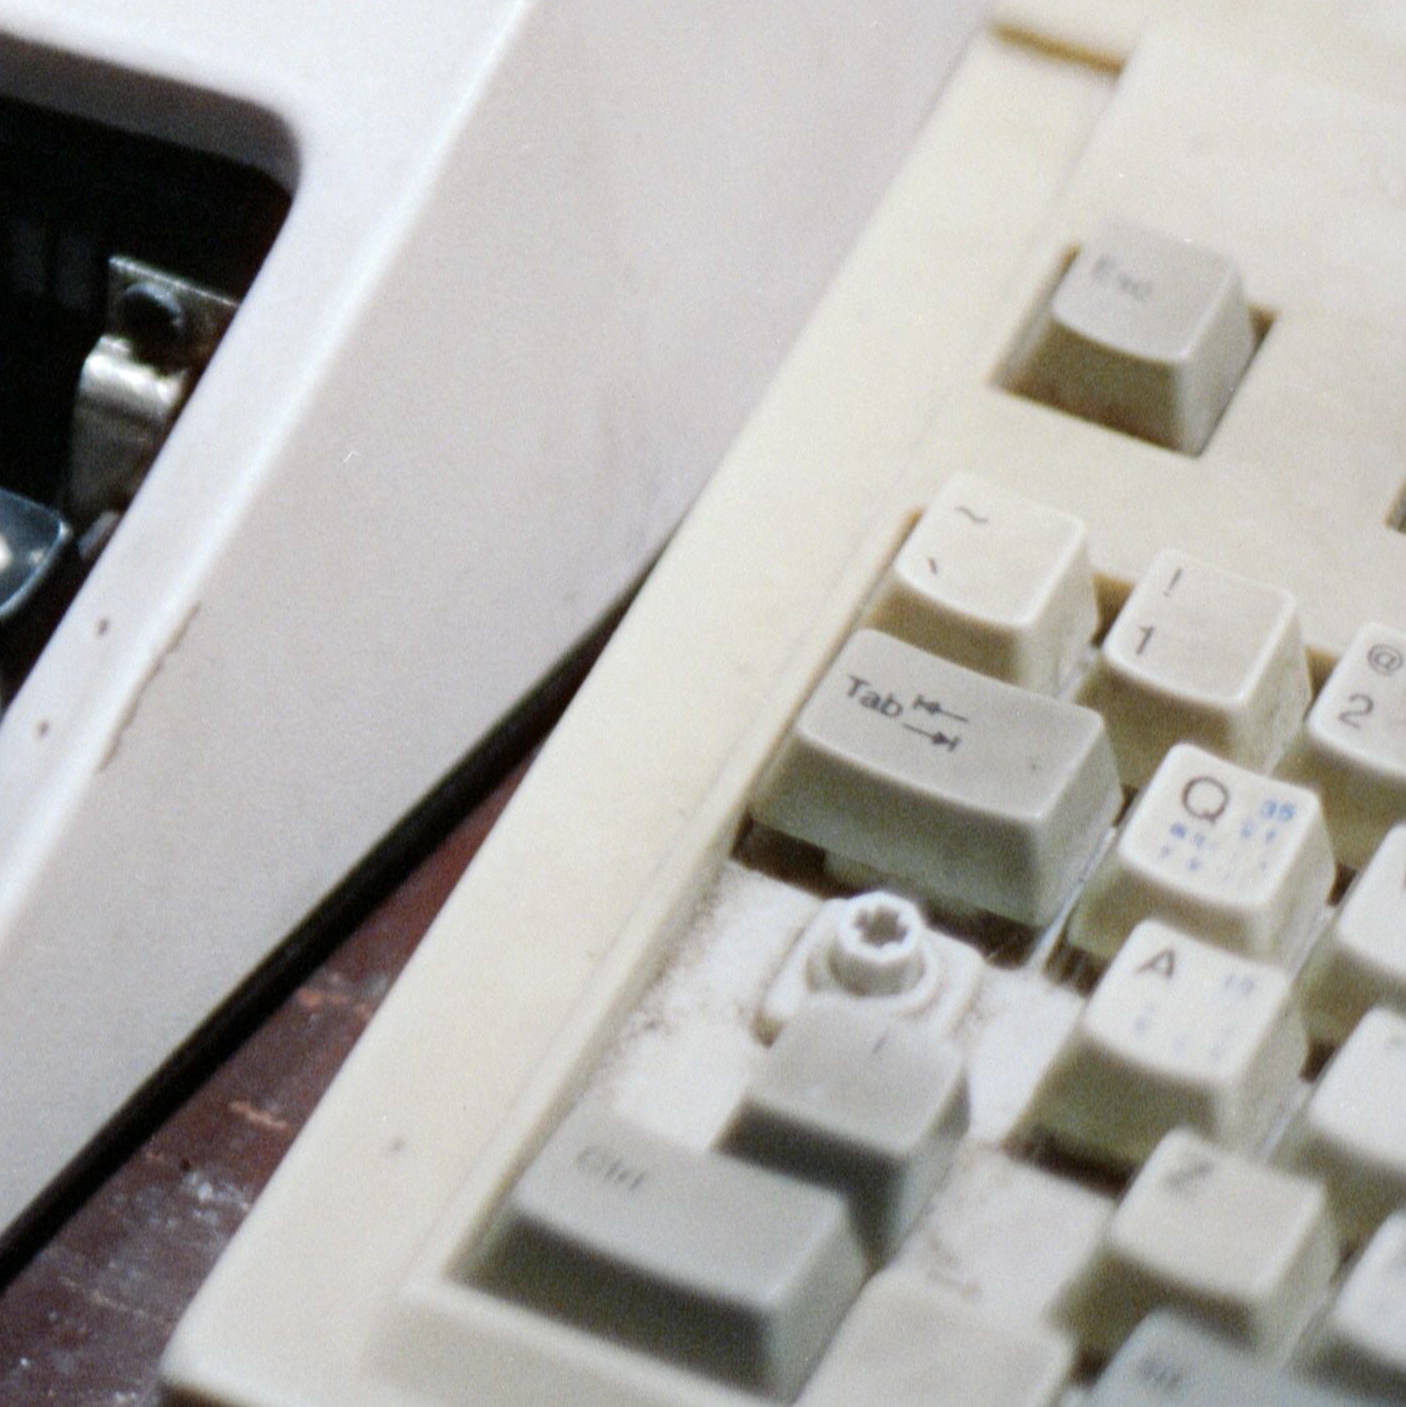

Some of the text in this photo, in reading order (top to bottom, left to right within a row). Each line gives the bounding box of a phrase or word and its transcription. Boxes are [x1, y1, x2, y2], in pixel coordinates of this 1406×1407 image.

[1138, 624, 1156, 656] 1
[846, 672, 904, 720] Tab
[1339, 692, 1375, 731] 2
[1181, 773, 1230, 826] Q
[1135, 948, 1177, 982] A
